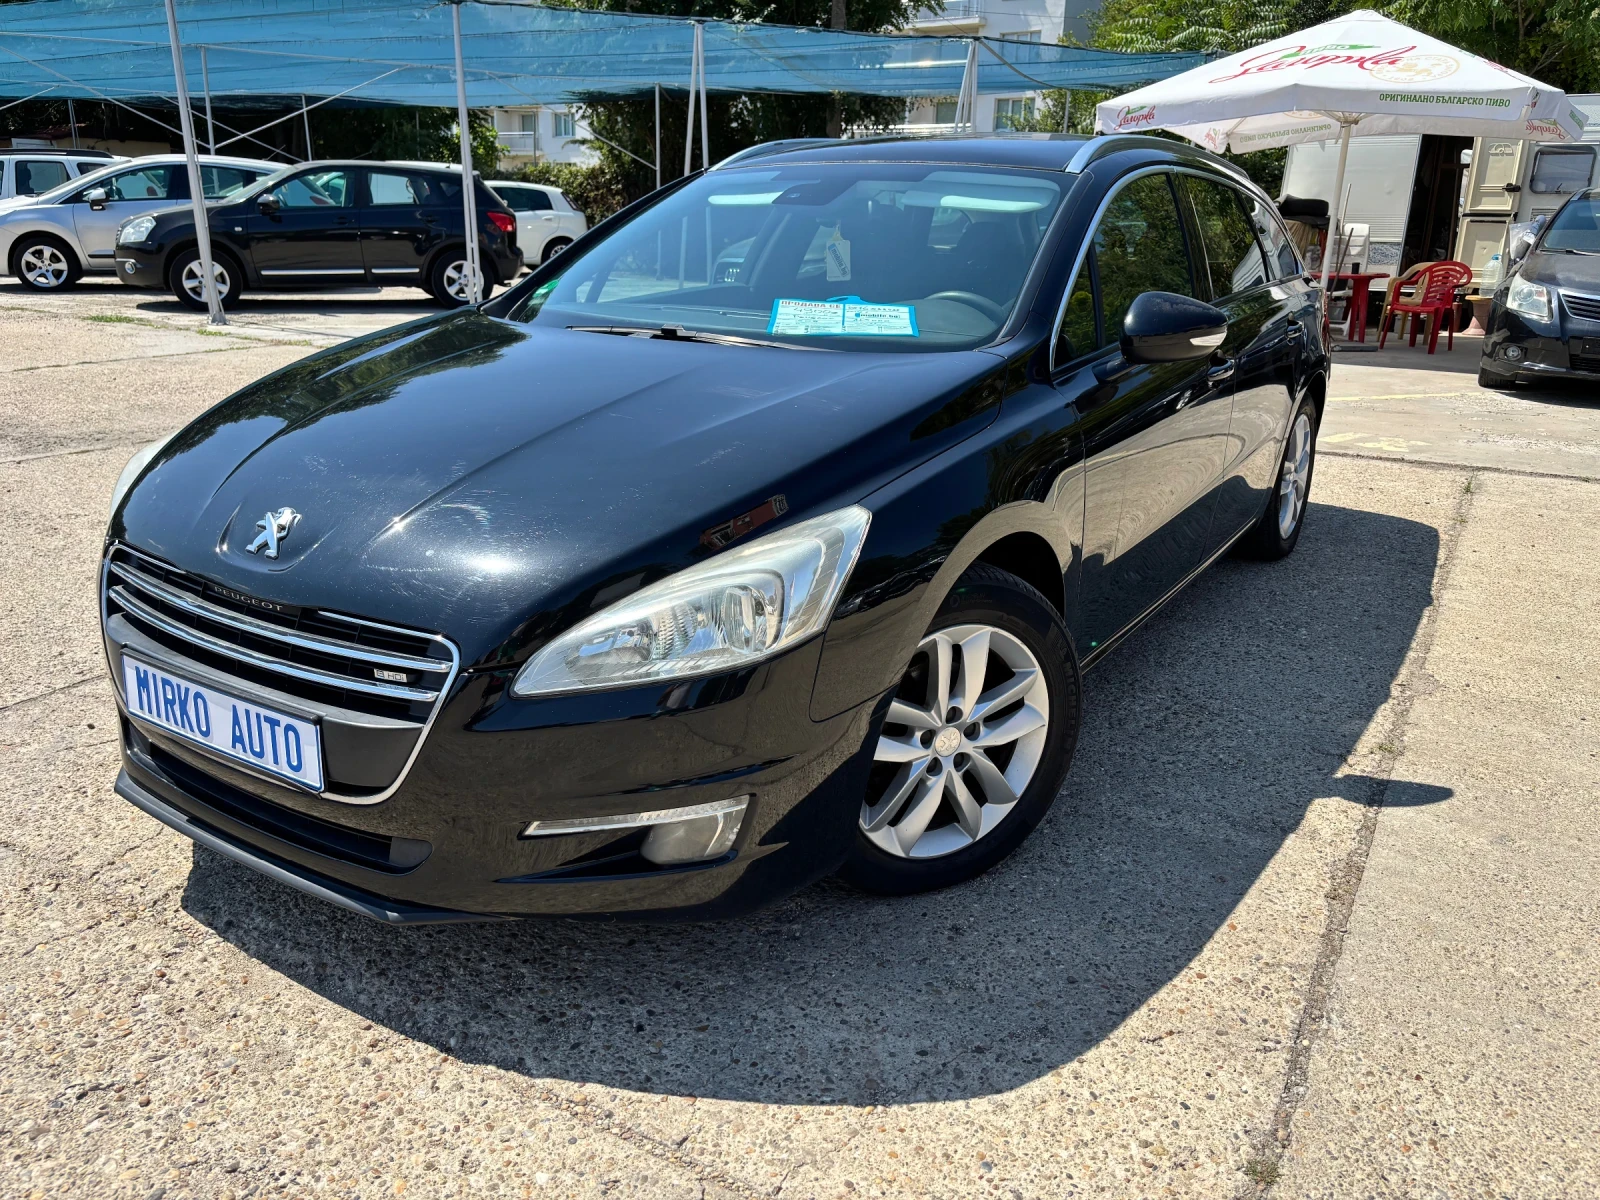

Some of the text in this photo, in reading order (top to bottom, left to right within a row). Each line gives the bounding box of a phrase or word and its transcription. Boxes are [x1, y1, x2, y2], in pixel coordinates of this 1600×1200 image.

[1379, 93, 1511, 108] ОРИГИНАЛНО БЪЛГАРСКО ПИВО
[214, 586, 283, 611] PEUGEOT
[135, 665, 303, 773] MIRKO AUTO
